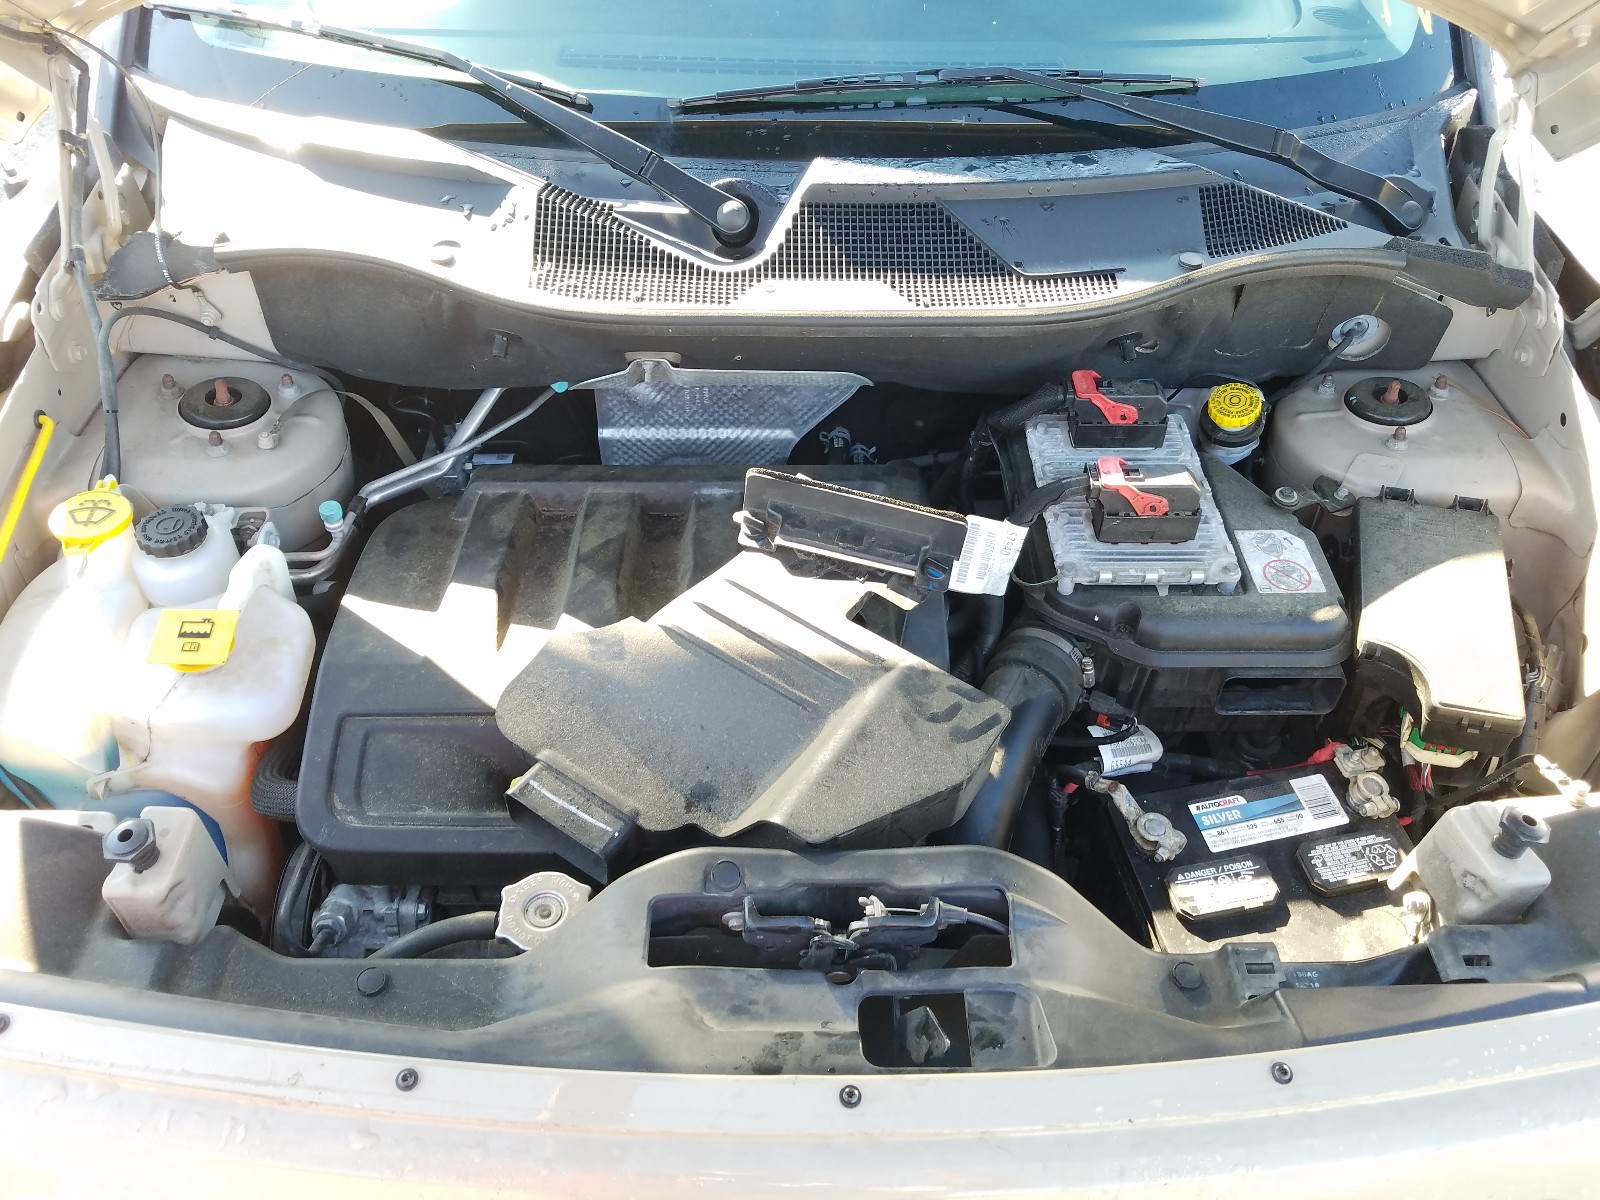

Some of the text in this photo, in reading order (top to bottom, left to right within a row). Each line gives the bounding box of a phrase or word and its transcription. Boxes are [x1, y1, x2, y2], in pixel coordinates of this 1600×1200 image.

[1201, 797, 1240, 811] AUTOCRAFT
[1201, 809, 1242, 826] SILVER
[1184, 867, 1217, 880] DANGER
[1223, 860, 1253, 871] POISON
